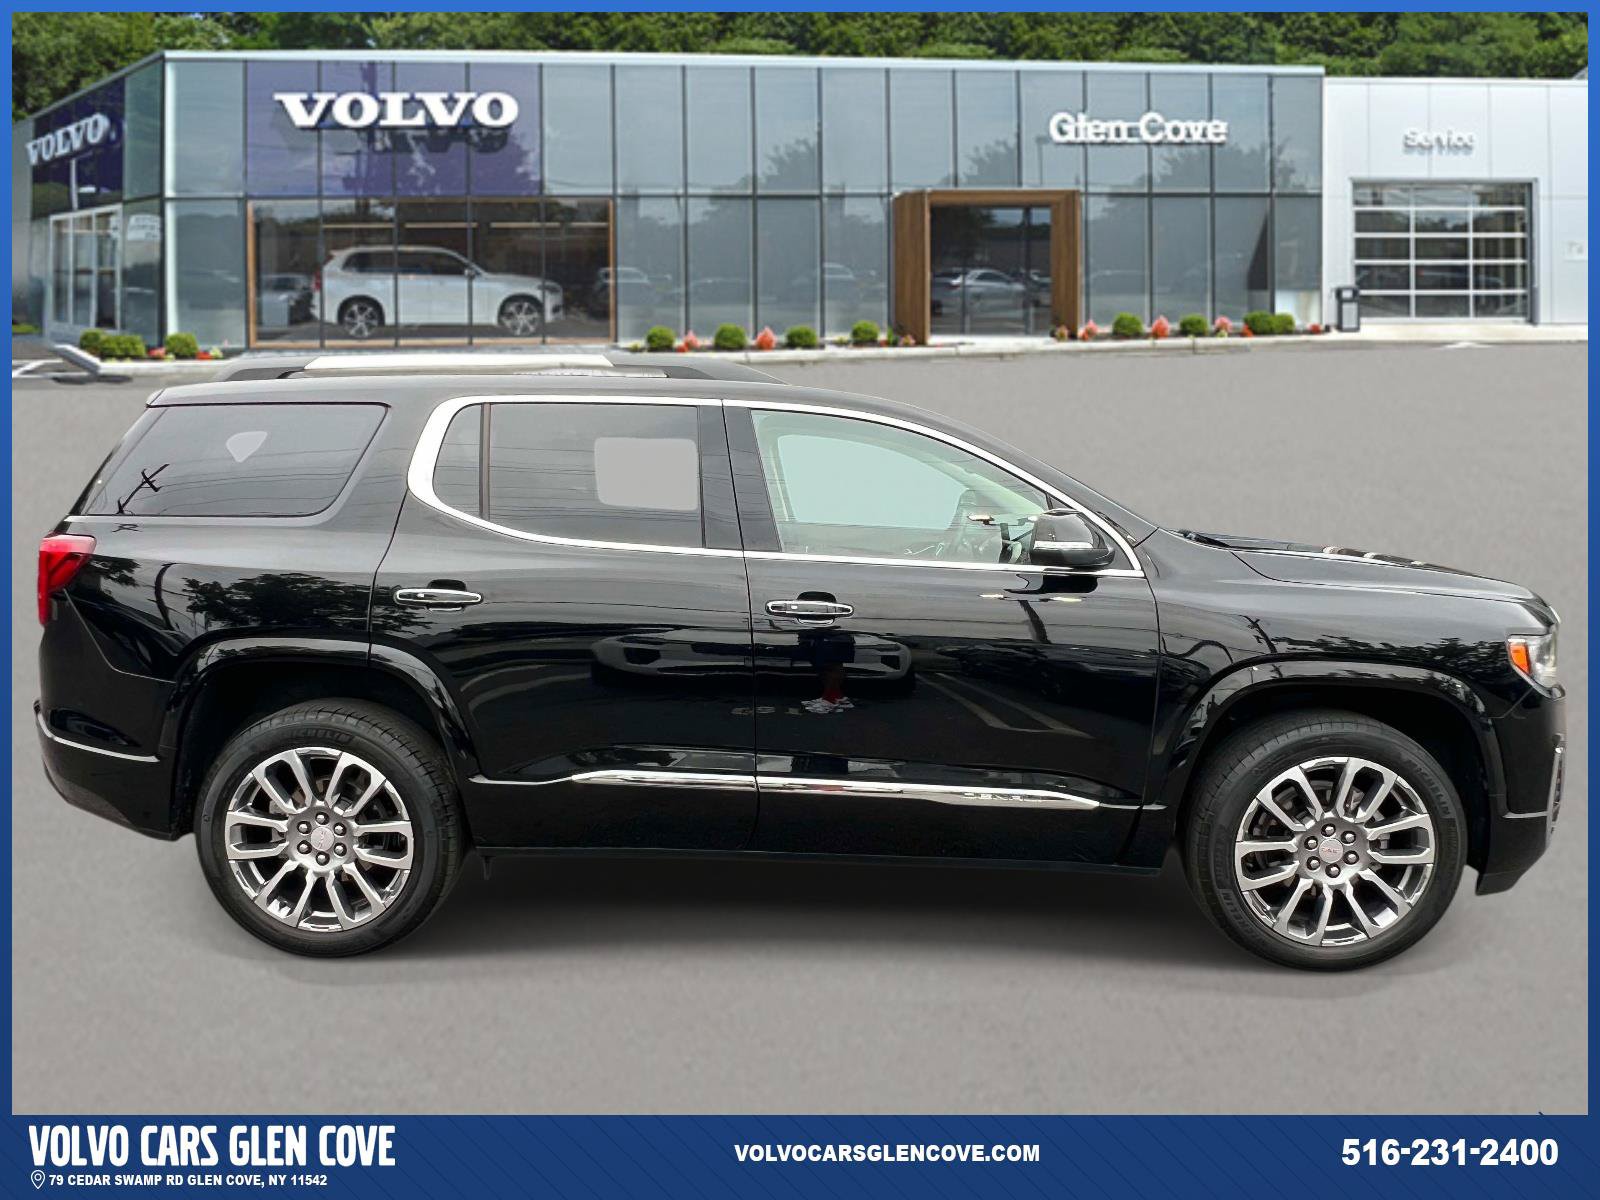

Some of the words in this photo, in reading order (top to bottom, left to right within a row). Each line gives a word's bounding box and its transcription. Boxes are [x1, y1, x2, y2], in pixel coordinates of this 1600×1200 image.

[273, 92, 519, 127] VOLVO
[26, 113, 110, 166] VOLVO
[1049, 112, 1128, 143] Glen
[1138, 112, 1229, 143] Cove
[1402, 127, 1476, 149] Service
